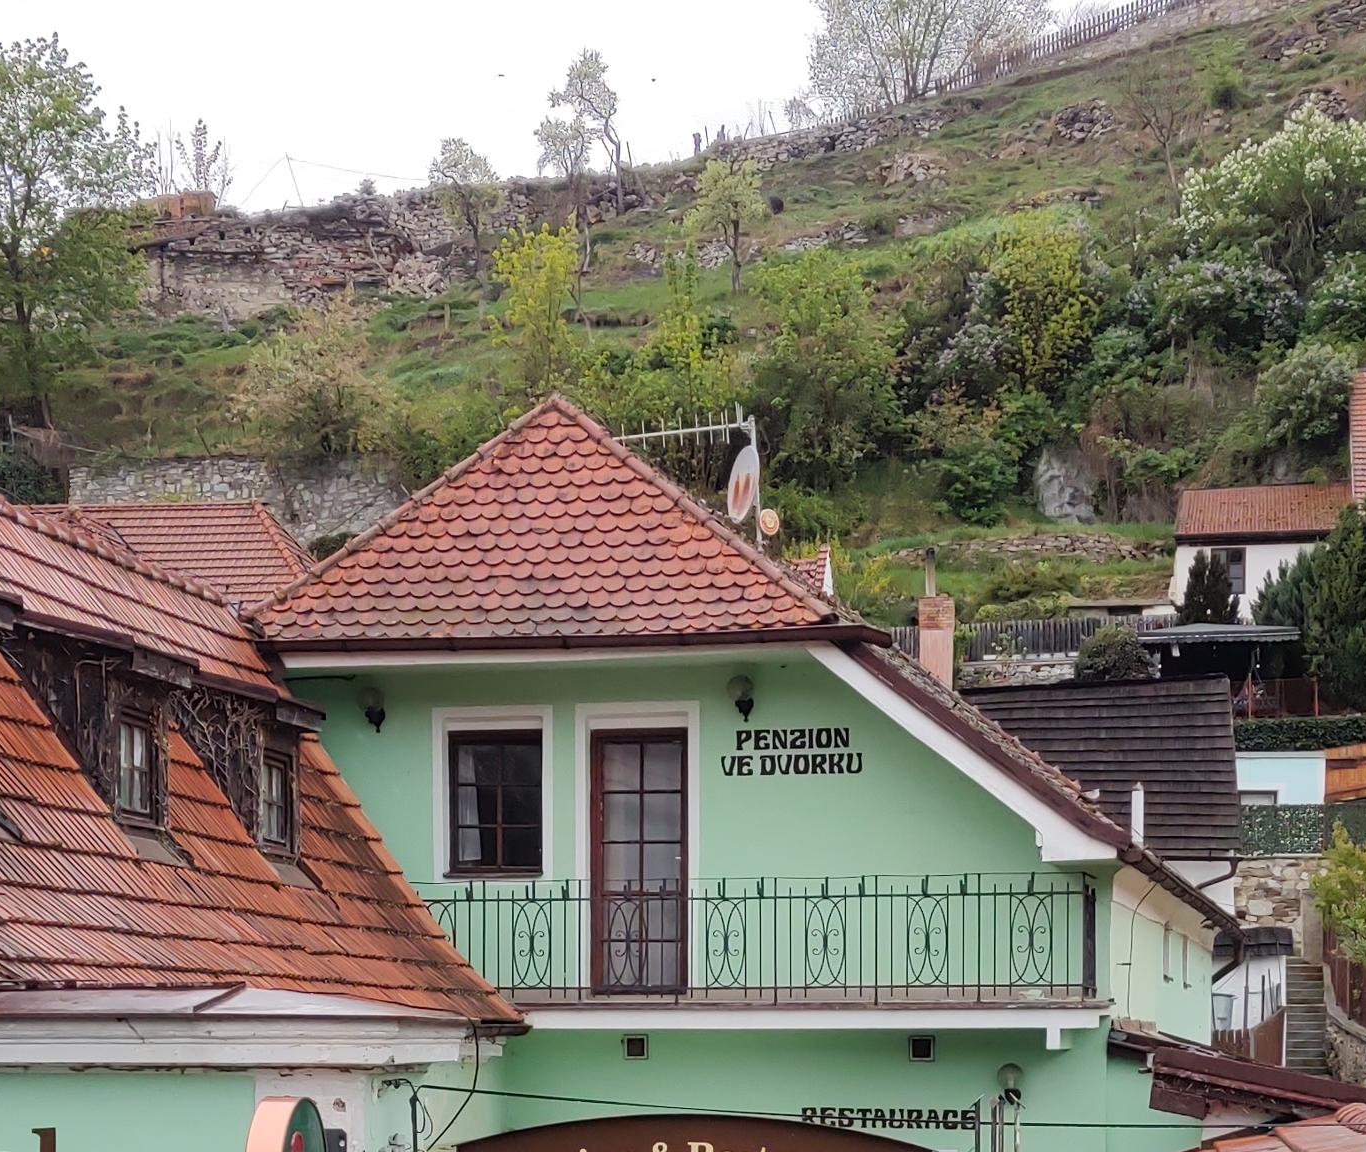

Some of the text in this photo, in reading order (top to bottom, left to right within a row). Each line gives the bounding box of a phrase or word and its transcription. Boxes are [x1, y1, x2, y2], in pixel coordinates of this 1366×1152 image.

[736, 727, 850, 750] PENZION
[721, 752, 863, 776] VE DVORKU
[801, 1107, 976, 1130] RESTAURACE
